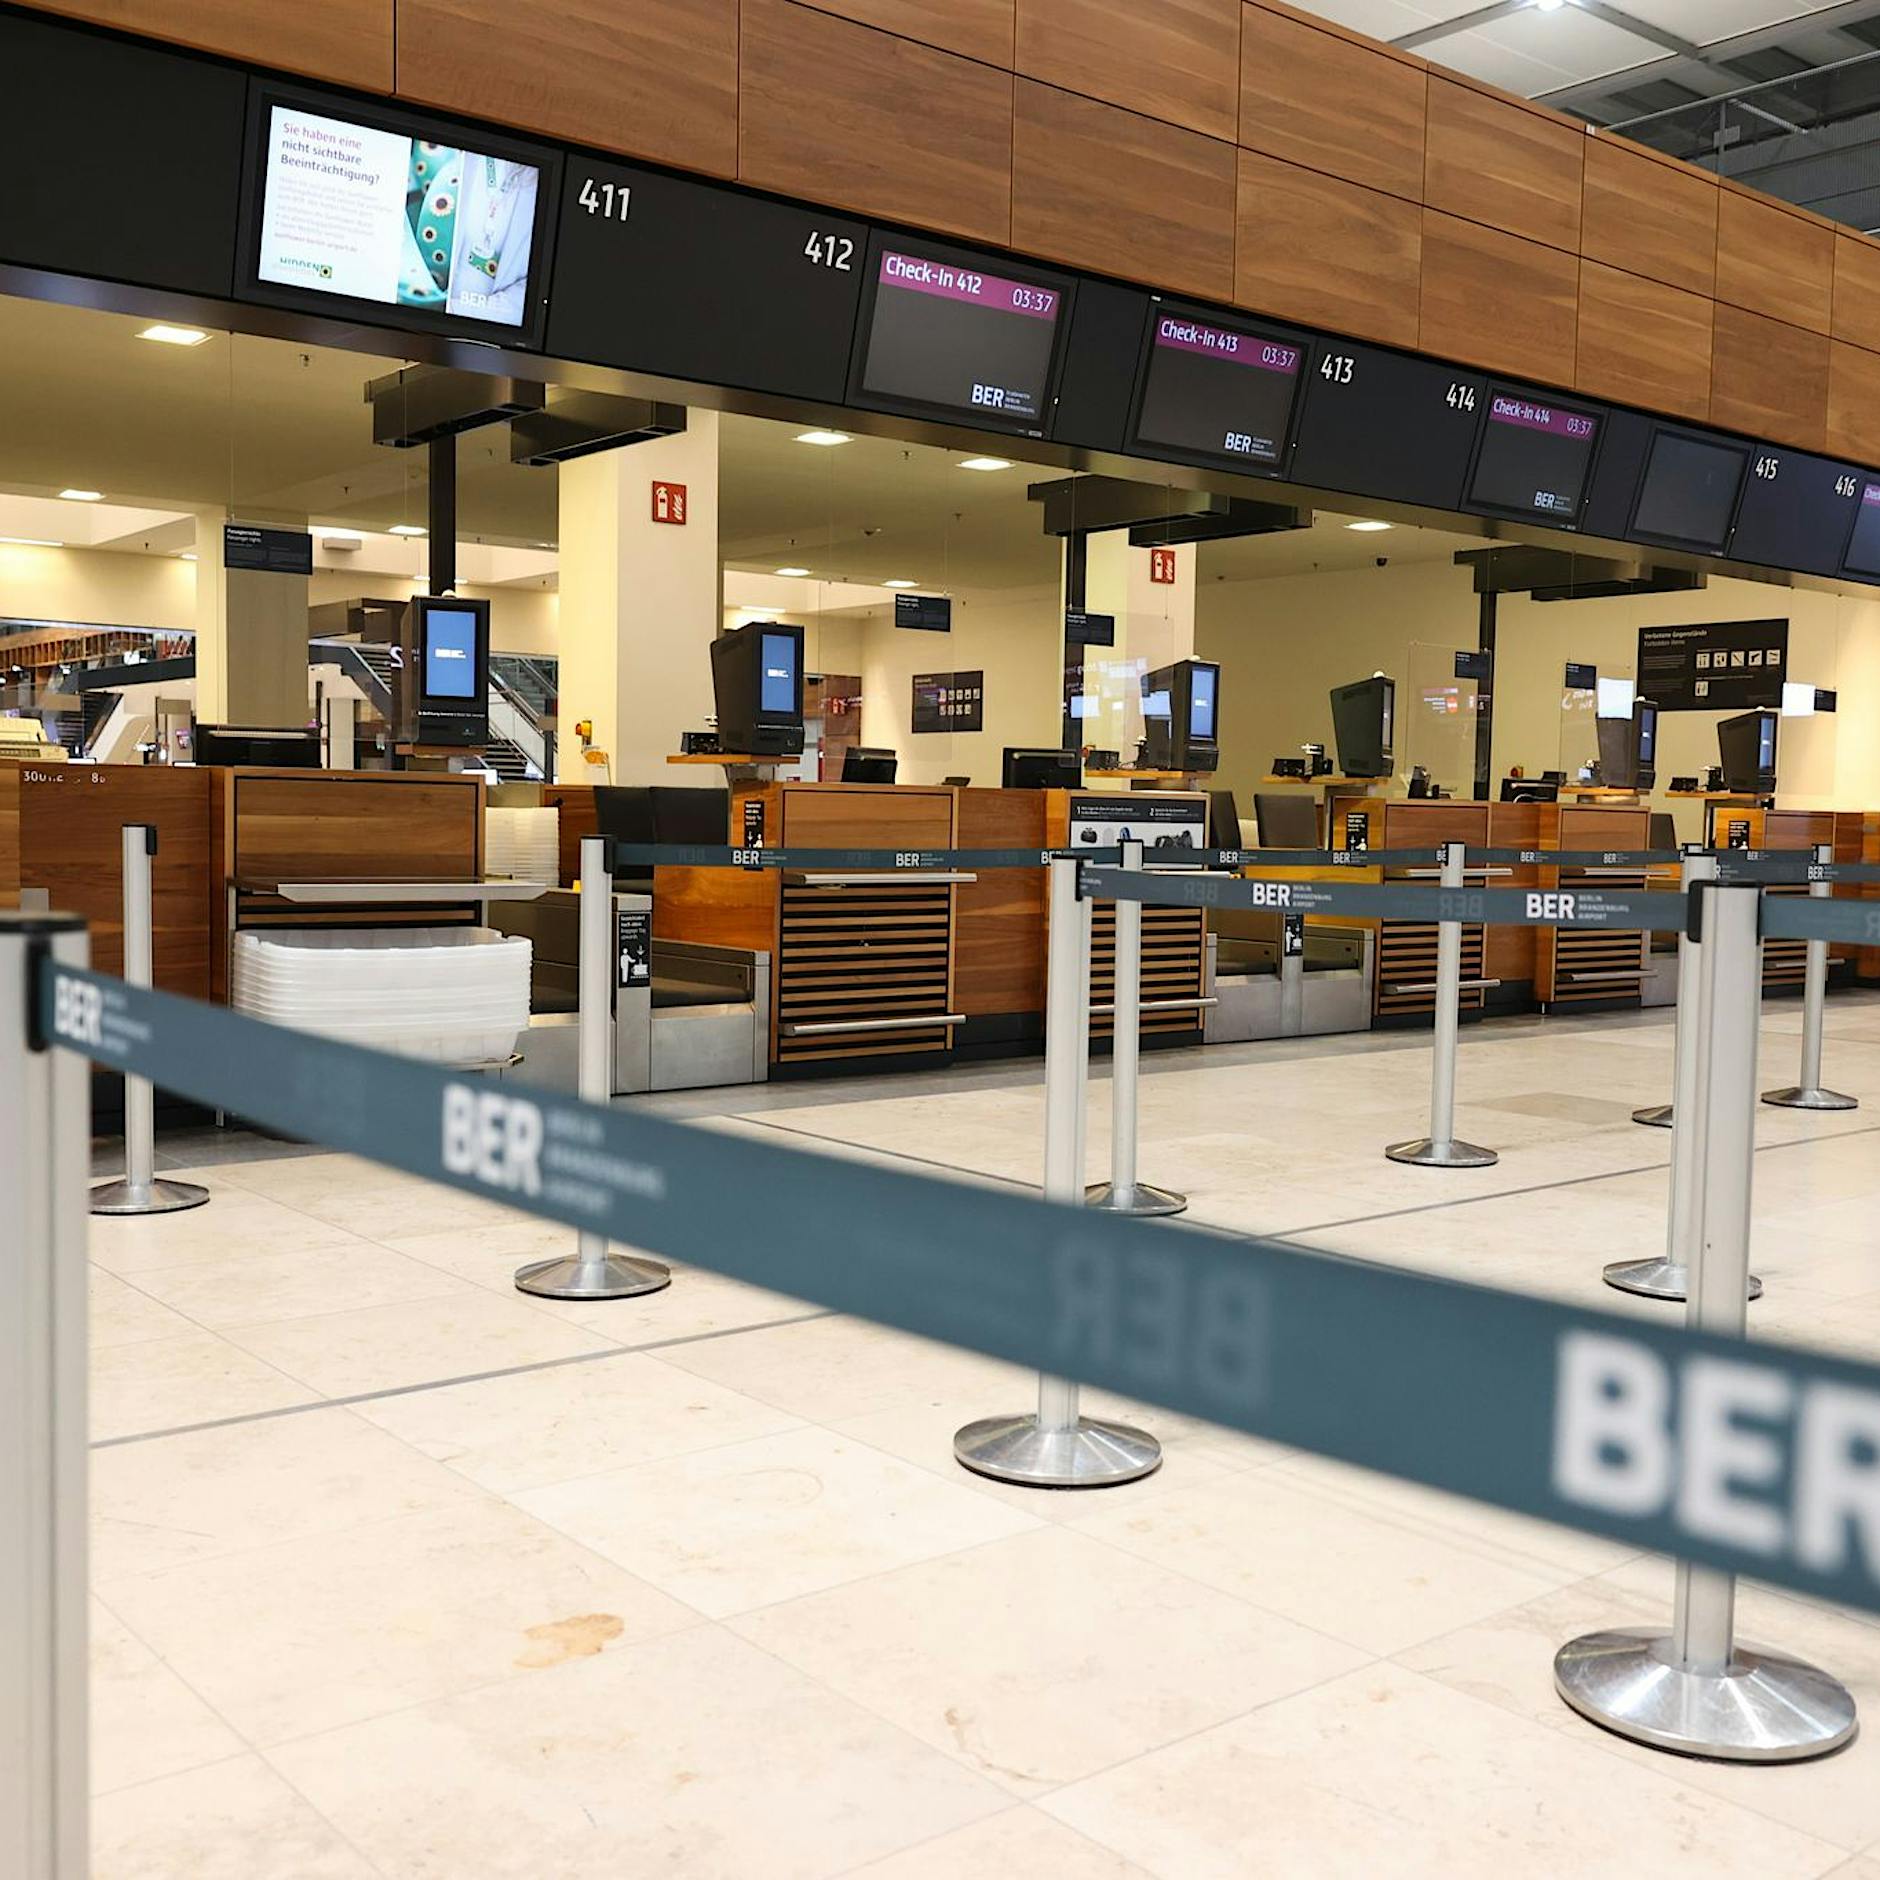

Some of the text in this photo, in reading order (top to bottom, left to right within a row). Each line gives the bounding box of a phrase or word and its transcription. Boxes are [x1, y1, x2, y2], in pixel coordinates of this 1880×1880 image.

[283, 122, 362, 150] Sie haben eine
[282, 139, 362, 165] nicht sichtbare
[578, 179, 631, 221] 411
[804, 231, 854, 271] 412
[886, 256, 1053, 312] Check-In 412 03:37
[1160, 320, 1296, 368] Check-In 413 03:37
[1320, 354, 1355, 384] 413
[971, 383, 1004, 408] BER
[1446, 383, 1475, 412] 414
[1493, 398, 1593, 436] Check-In 414 03:37
[1224, 432, 1252, 453] BER
[1755, 456, 1779, 480] 415
[1834, 475, 1857, 497] 416
[1534, 491, 1555, 510] BER
[733, 850, 760, 865] BER
[896, 853, 920, 867] BER
[1219, 851, 1239, 863] BER
[1333, 852, 1351, 864] BER
[1520, 851, 1536, 863] BER
[1603, 853, 1617, 864] BER
[1808, 865, 1824, 880] BER
[1253, 882, 1291, 907] BER
[1526, 893, 1575, 919] BER
[54, 974, 103, 1047] BER
[442, 1082, 544, 1197] BER
[1550, 1322, 1880, 1574] BER
